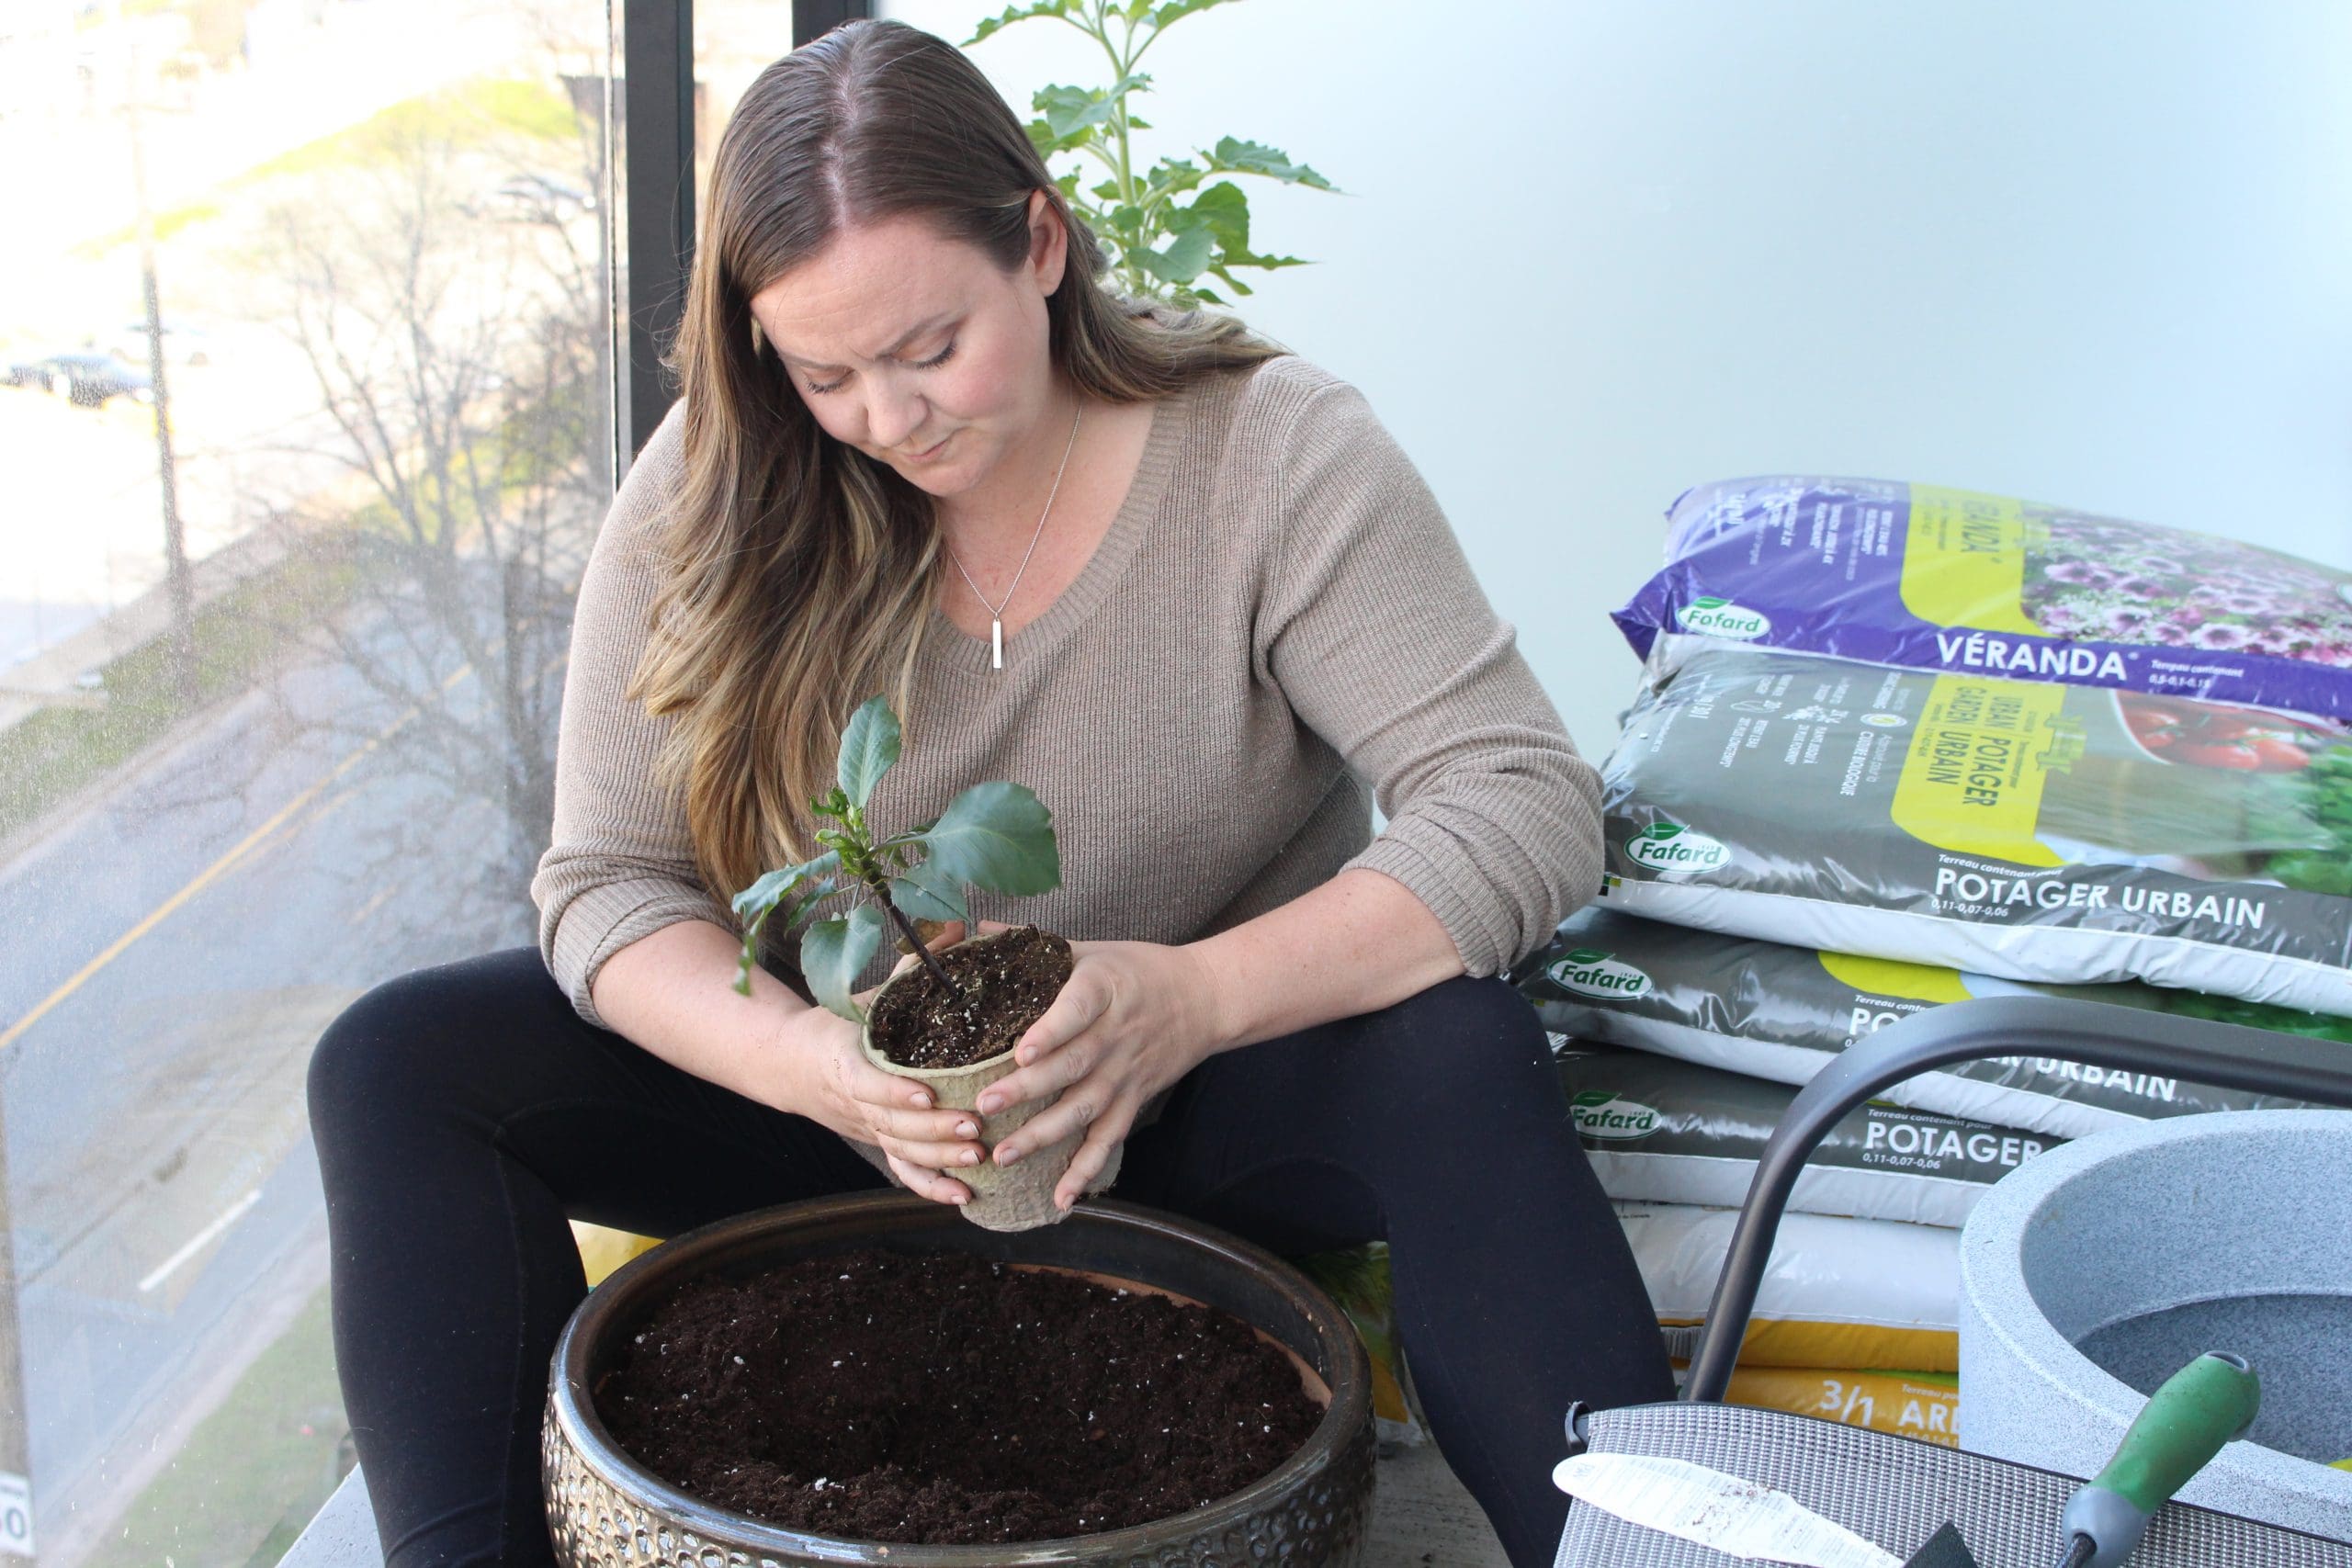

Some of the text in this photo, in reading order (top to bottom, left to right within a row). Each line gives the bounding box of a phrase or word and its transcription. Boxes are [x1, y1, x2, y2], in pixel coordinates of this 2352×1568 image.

[1936, 632, 2128, 681] VÉRANDA
[1946, 686, 1987, 725] GARDEN
[1984, 695, 2024, 729] URBAN
[1926, 730, 1973, 785] URBAIN
[1962, 735, 2012, 807] POTAGER
[1638, 841, 1723, 864] Fafard
[1938, 853, 1979, 869] Terreau
[1931, 897, 2009, 918] 0,11-0,07-0,06
[1935, 868, 2266, 930] POTAGER URBAIN
[1559, 964, 1645, 992] Fafard
[1854, 994, 1895, 1009] Terreau
[1574, 1108, 1654, 1131] Fafard
[1868, 1109, 1994, 1131] Terreau contenant pour
[1862, 1152, 1941, 1169] 0,11-0,07-0,06
[1819, 1380, 1874, 1427] 3/1
